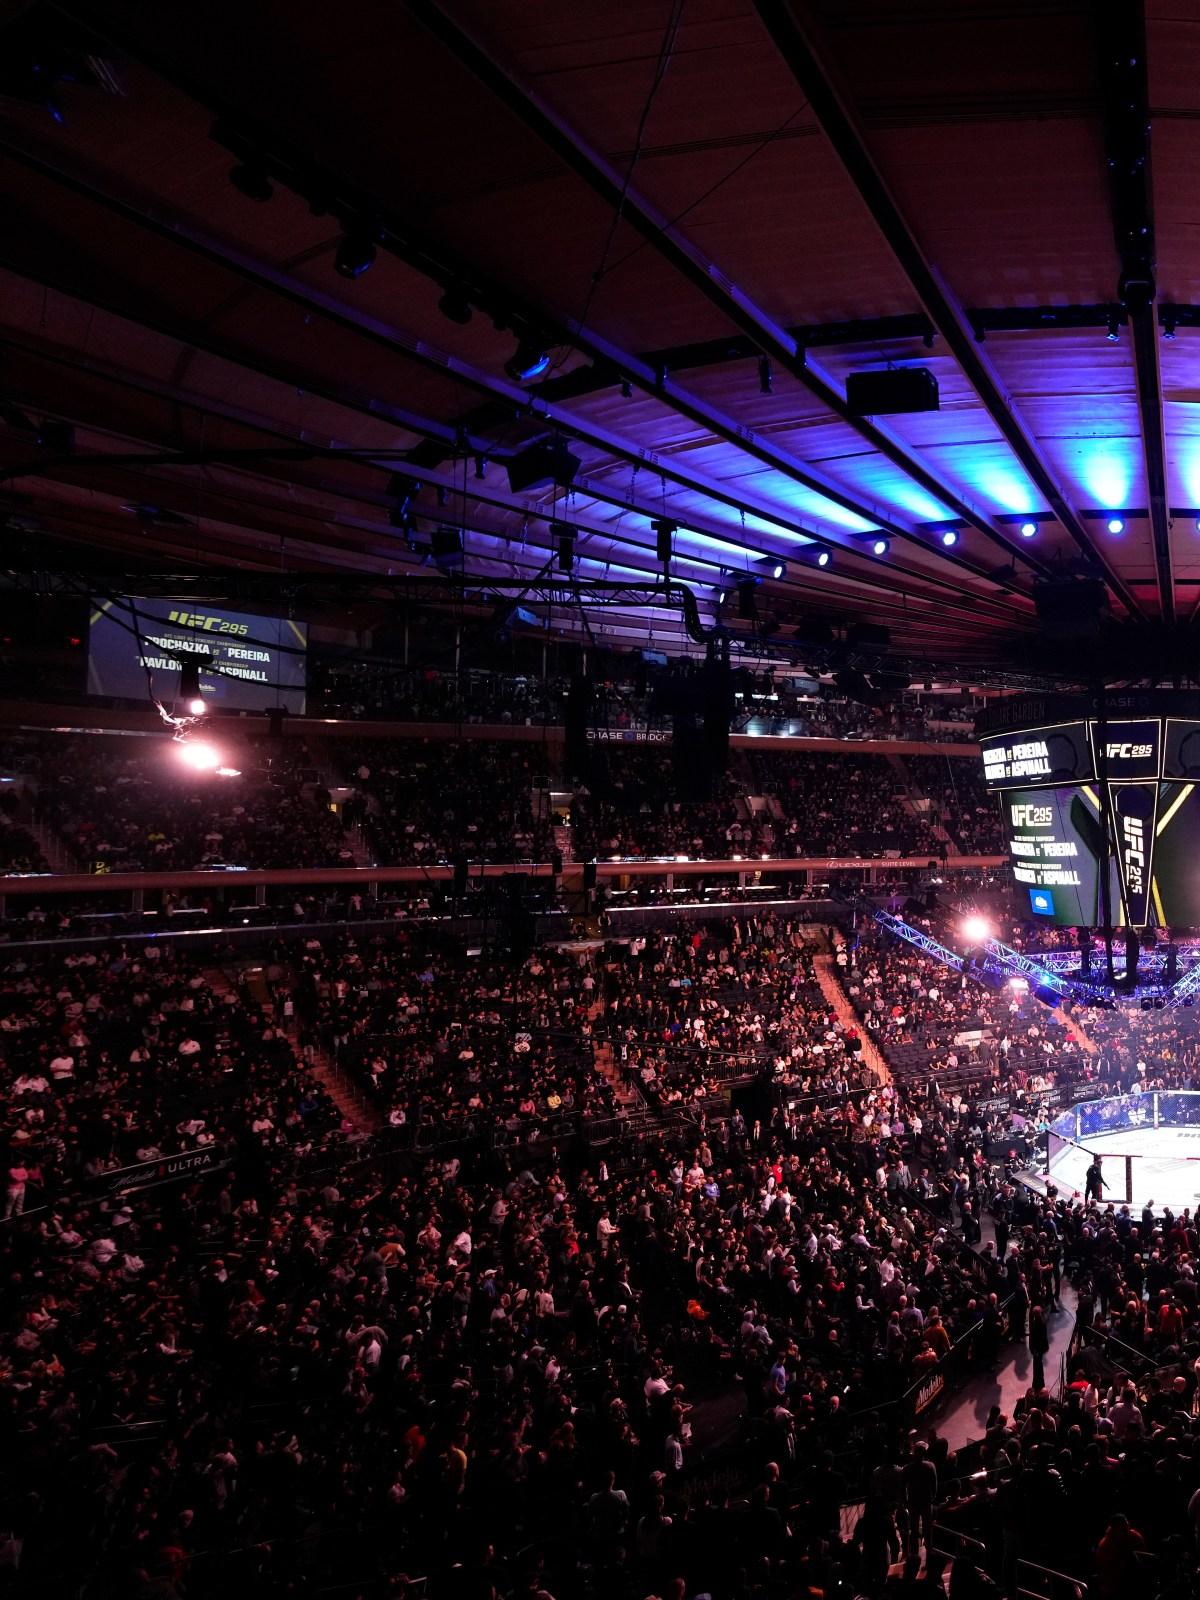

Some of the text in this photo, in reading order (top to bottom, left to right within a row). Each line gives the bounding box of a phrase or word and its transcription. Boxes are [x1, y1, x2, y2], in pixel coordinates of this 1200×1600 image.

[169, 611, 248, 635] UFC 295
[228, 648, 271, 662] PEREIRA
[220, 667, 269, 682] ASPINALL
[1092, 698, 1136, 709] CASE
[586, 731, 624, 740] CHASE
[1012, 741, 1049, 761] PEREIRA
[1131, 745, 1152, 755] 295
[1012, 757, 1052, 777] ASPINALL
[1011, 804, 1053, 827] UFC 295
[1123, 816, 1144, 867] UFC
[1044, 842, 1078, 857] PEREIRA
[1043, 870, 1082, 885] ASPINALL
[167, 1154, 211, 1173] ULTRA
